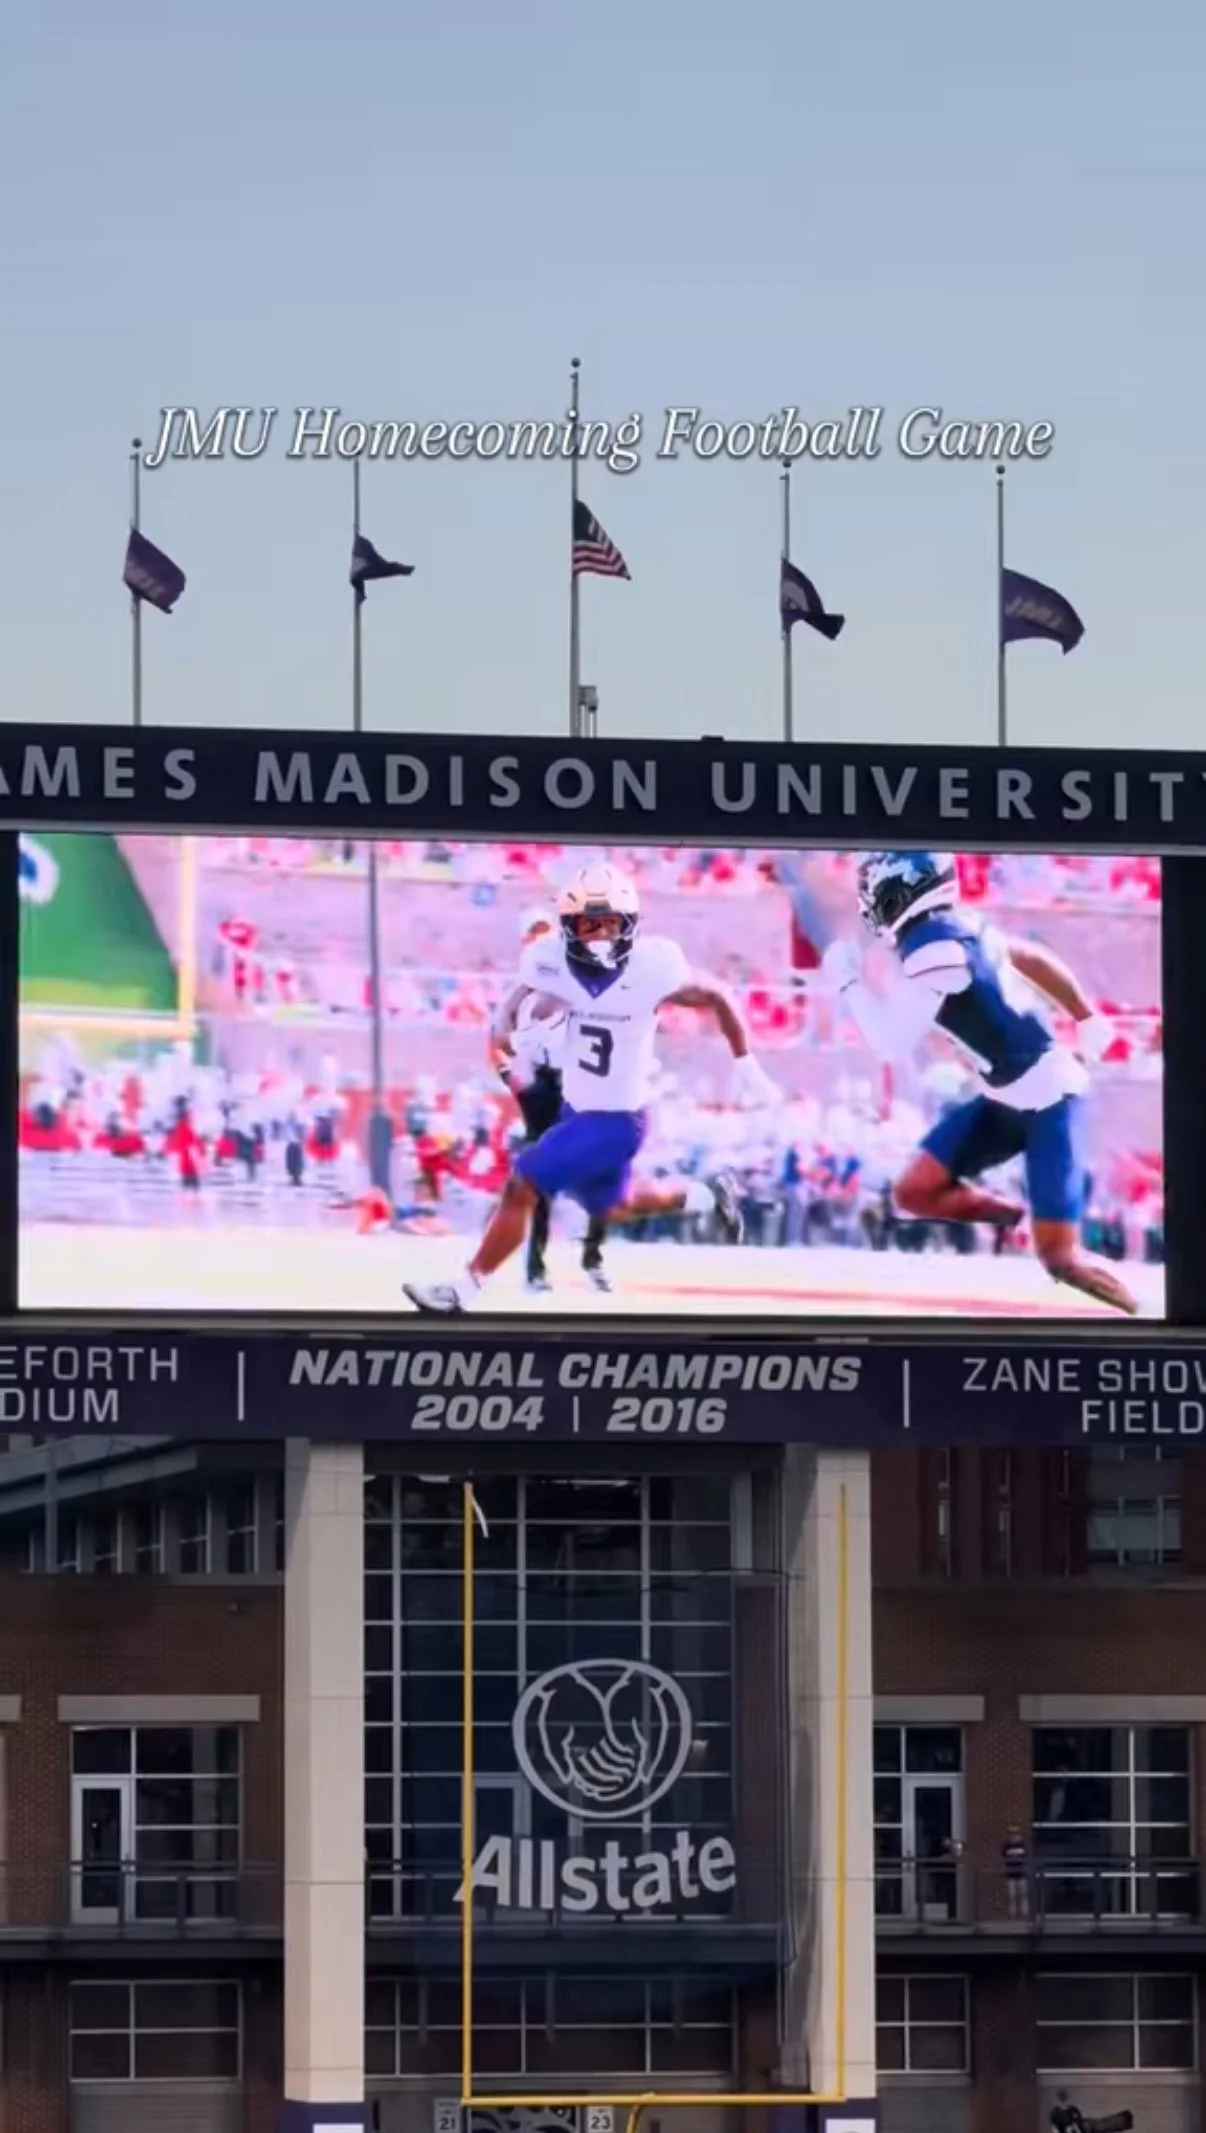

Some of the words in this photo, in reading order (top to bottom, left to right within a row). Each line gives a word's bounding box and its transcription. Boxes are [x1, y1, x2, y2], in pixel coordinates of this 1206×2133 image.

[0, 745, 197, 800] MES
[254, 751, 657, 810] MADISON
[712, 761, 1206, 822] UNIVERSIT
[578, 1024, 614, 1078] 3
[289, 1349, 544, 1388] NATIONAL
[558, 1353, 862, 1392] CHAMPIONS
[963, 1357, 1081, 1393] ZANE
[0, 1387, 119, 1423] DIUM
[411, 1394, 544, 1431] 2004
[606, 1397, 727, 1433] 2016
[1082, 1399, 1205, 1435] FIELD
[452, 1831, 737, 1912] Allstate
[439, 2116, 457, 2131] 21
[591, 2115, 611, 2130] 23
